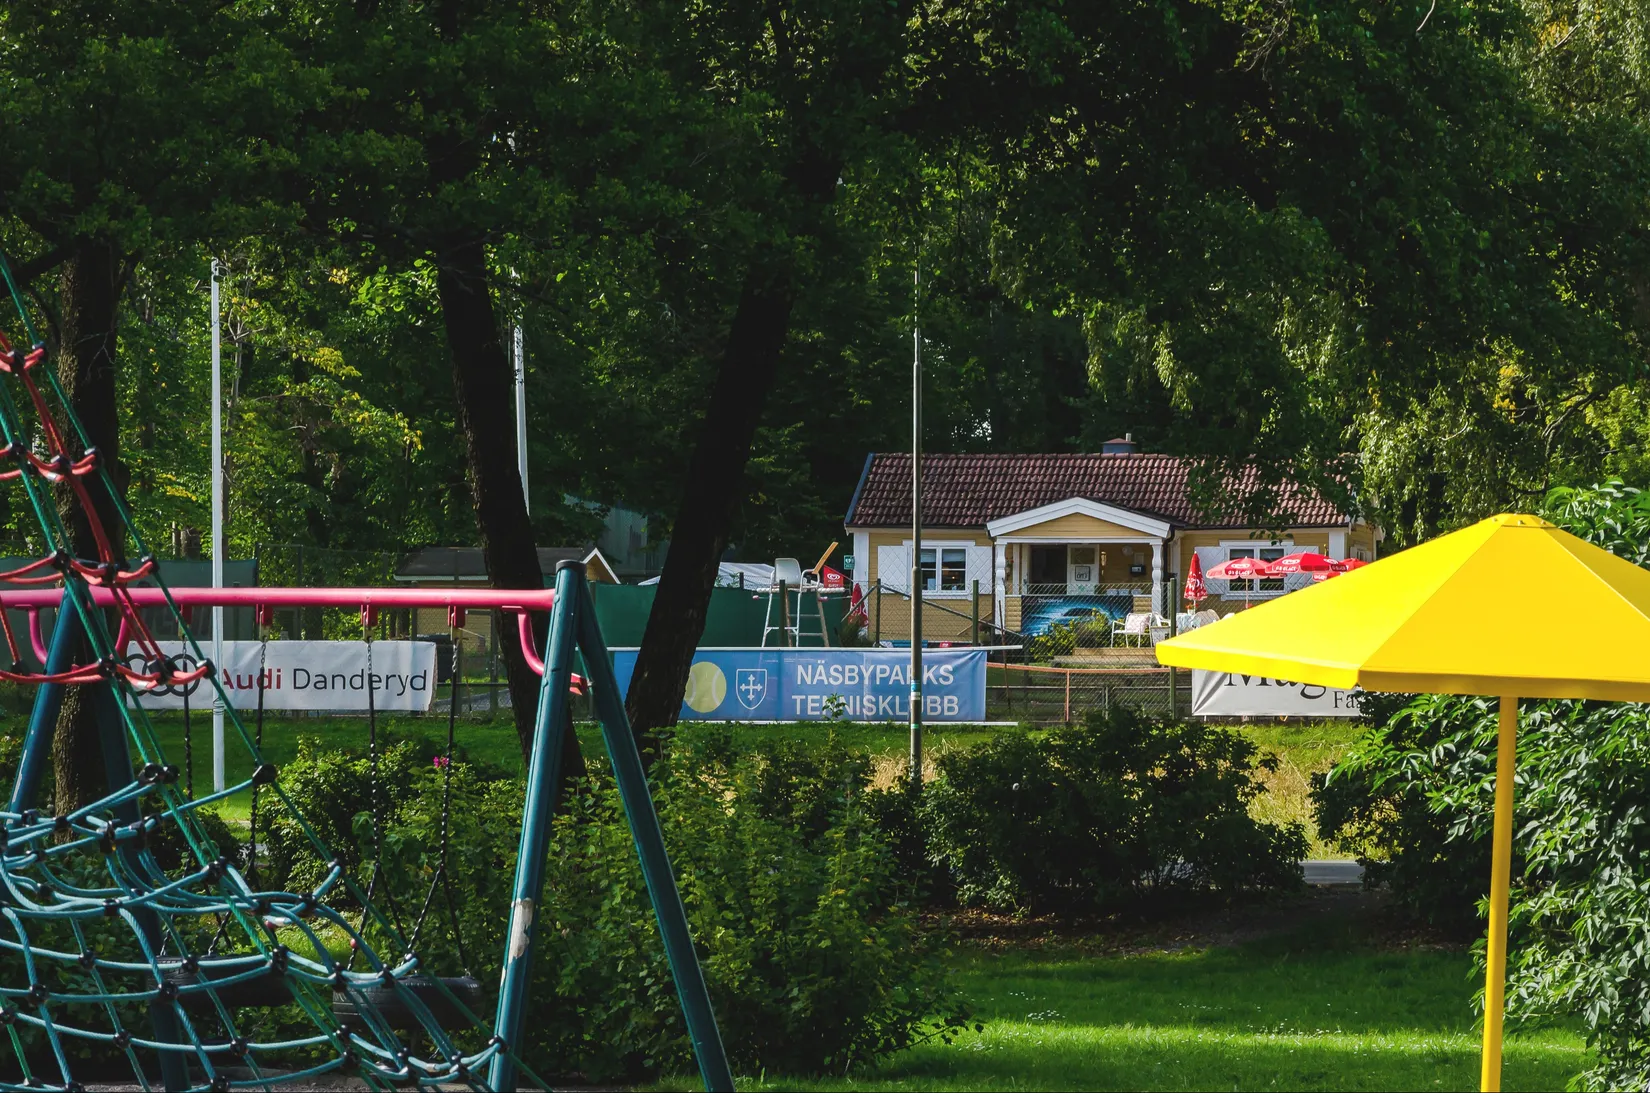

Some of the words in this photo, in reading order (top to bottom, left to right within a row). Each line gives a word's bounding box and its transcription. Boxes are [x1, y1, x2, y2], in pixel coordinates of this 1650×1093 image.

[223, 668, 282, 690] Audi
[293, 668, 427, 697] Danderyd
[791, 695, 959, 716] TENISKLBB
